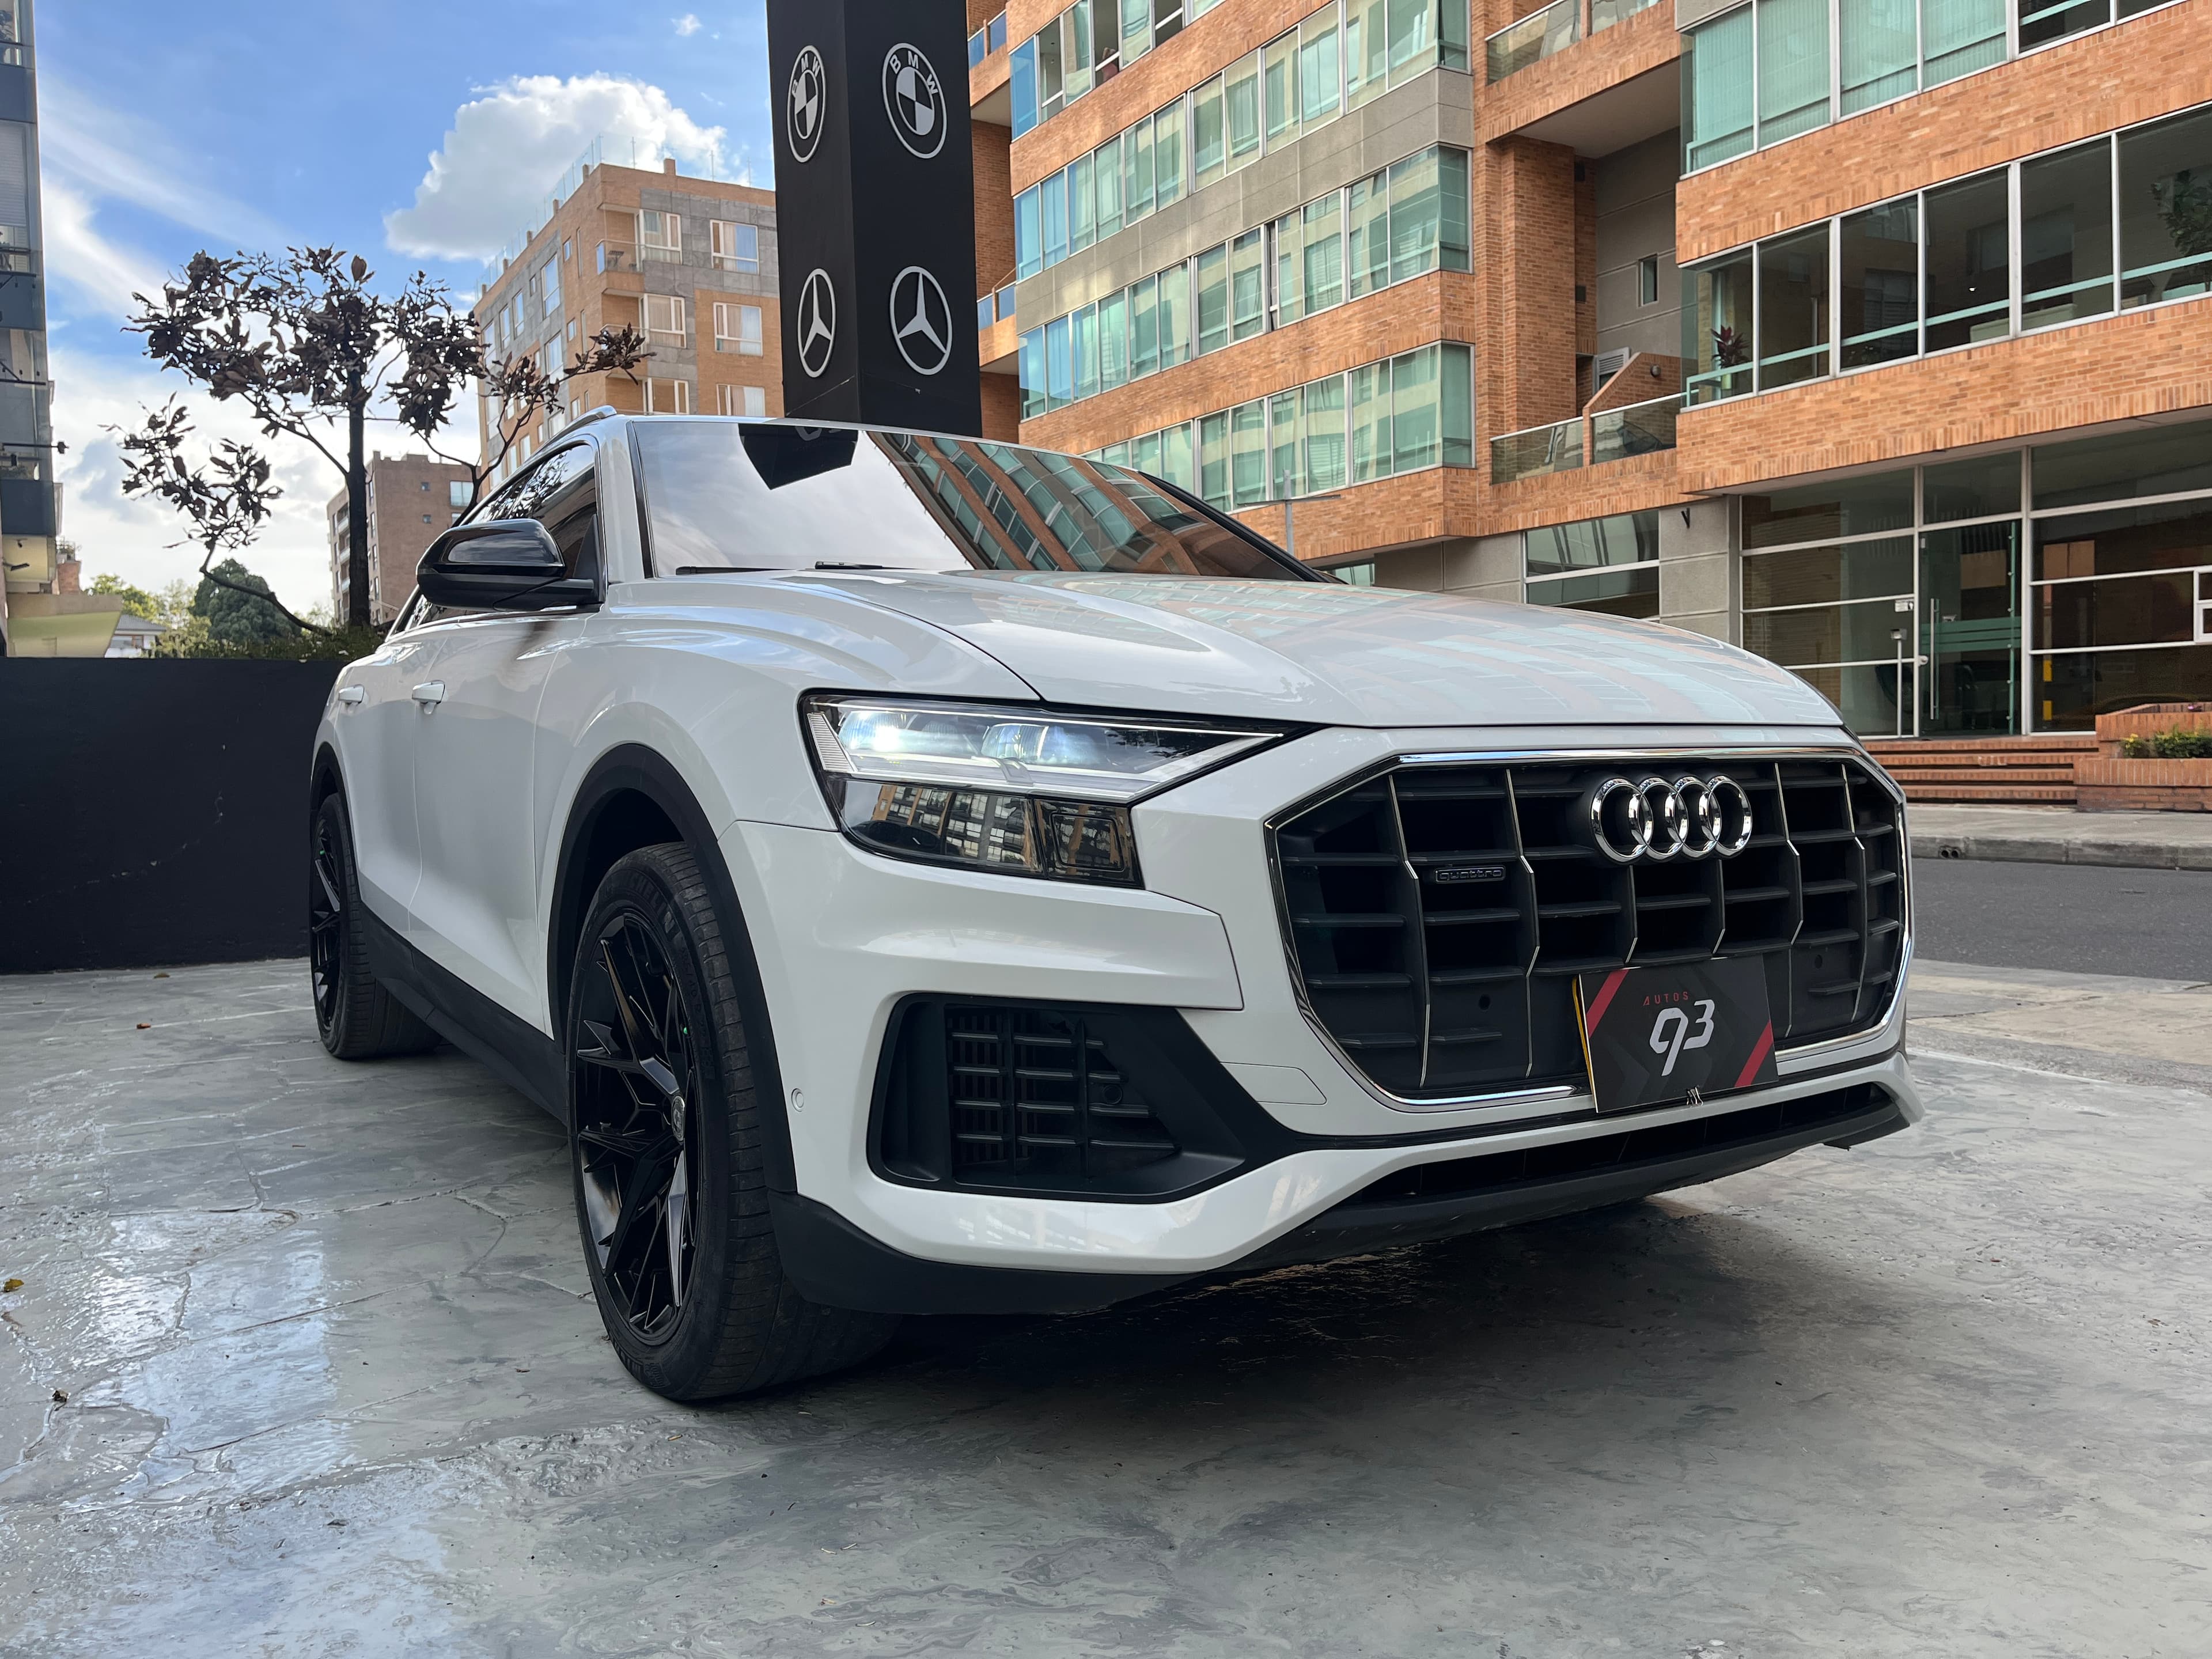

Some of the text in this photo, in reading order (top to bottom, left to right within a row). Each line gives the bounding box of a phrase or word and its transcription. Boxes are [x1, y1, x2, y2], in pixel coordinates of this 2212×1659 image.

[791, 53, 820, 99] BMW
[889, 50, 938, 95] BMW
[1440, 870, 1502, 881] quattro
[1643, 991, 1689, 1006] AUTOS
[1649, 999, 1715, 1076] 93
